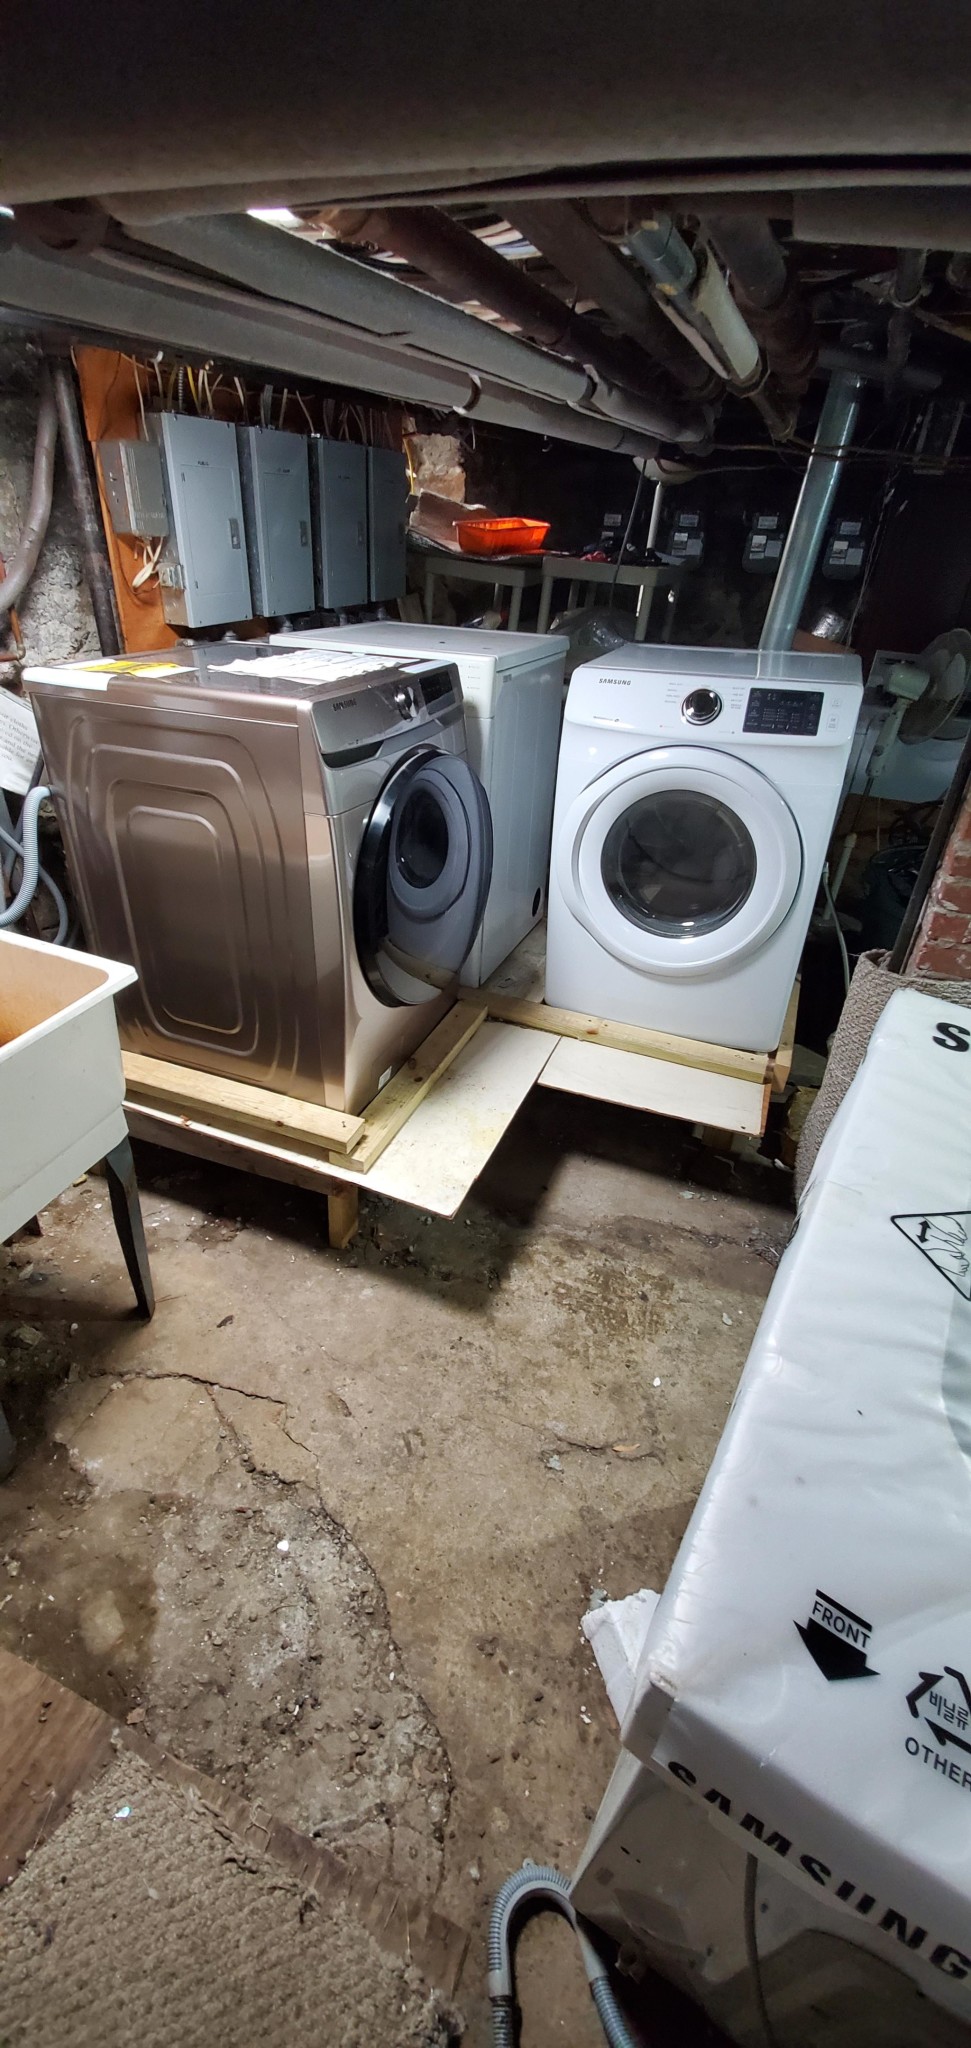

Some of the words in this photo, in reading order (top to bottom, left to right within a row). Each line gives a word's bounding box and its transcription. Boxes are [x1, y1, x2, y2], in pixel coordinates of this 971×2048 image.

[598, 678, 631, 686] SAMSUNG
[932, 1022, 971, 1052] S
[812, 1600, 871, 1648] FRONT
[929, 1690, 969, 1731] 비닐류
[905, 1737, 971, 1791] OTHER
